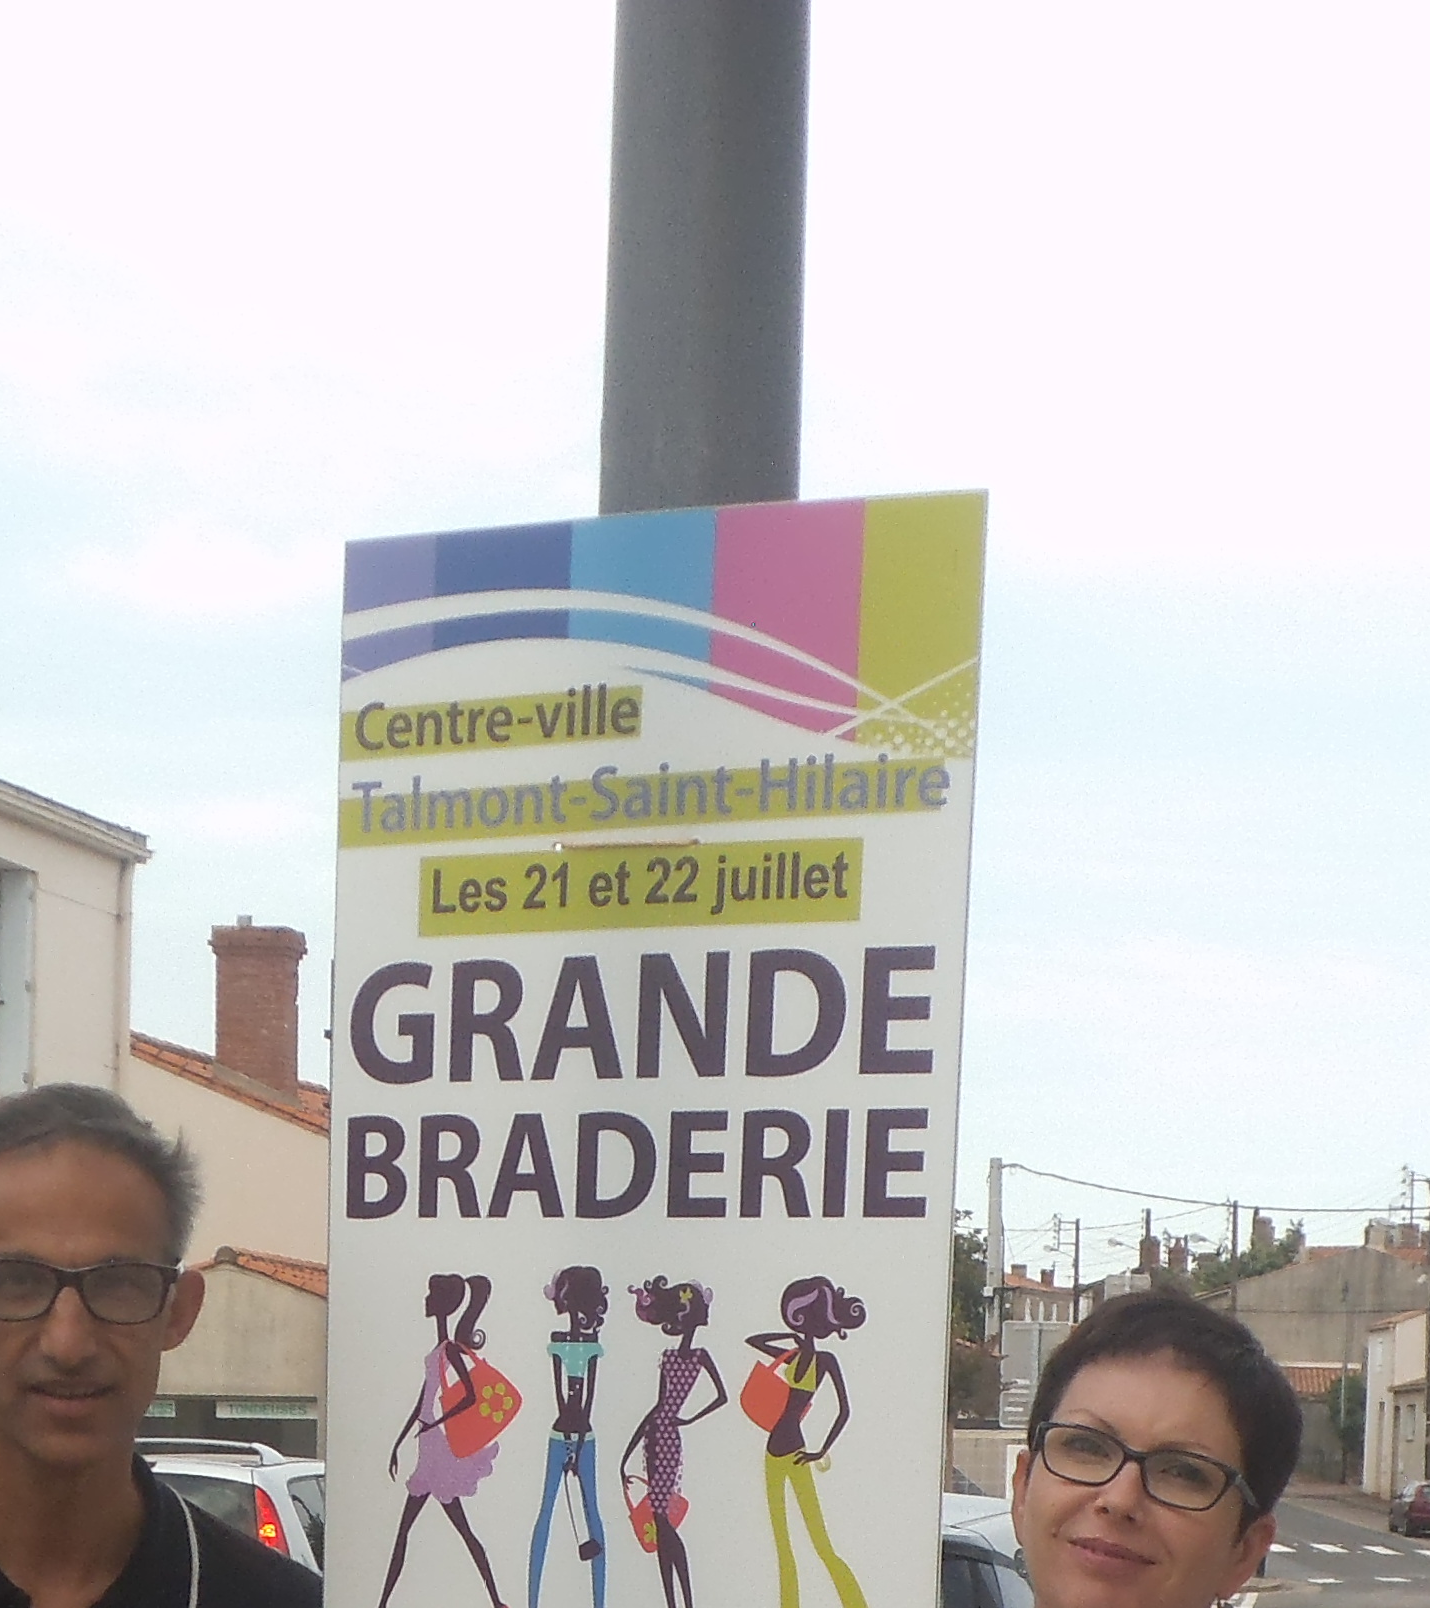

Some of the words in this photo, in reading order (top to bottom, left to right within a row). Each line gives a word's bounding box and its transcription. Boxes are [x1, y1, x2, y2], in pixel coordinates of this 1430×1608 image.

[355, 684, 641, 751] Centre-ville
[352, 754, 951, 833] Talmont-Saint-Hilaire
[432, 868, 508, 914] Les
[523, 861, 570, 909] 21
[589, 863, 630, 906] et
[646, 855, 699, 904] 22
[710, 850, 850, 915] juillet
[349, 945, 937, 1083] GRANDE
[345, 1107, 930, 1219] BRADERIE
